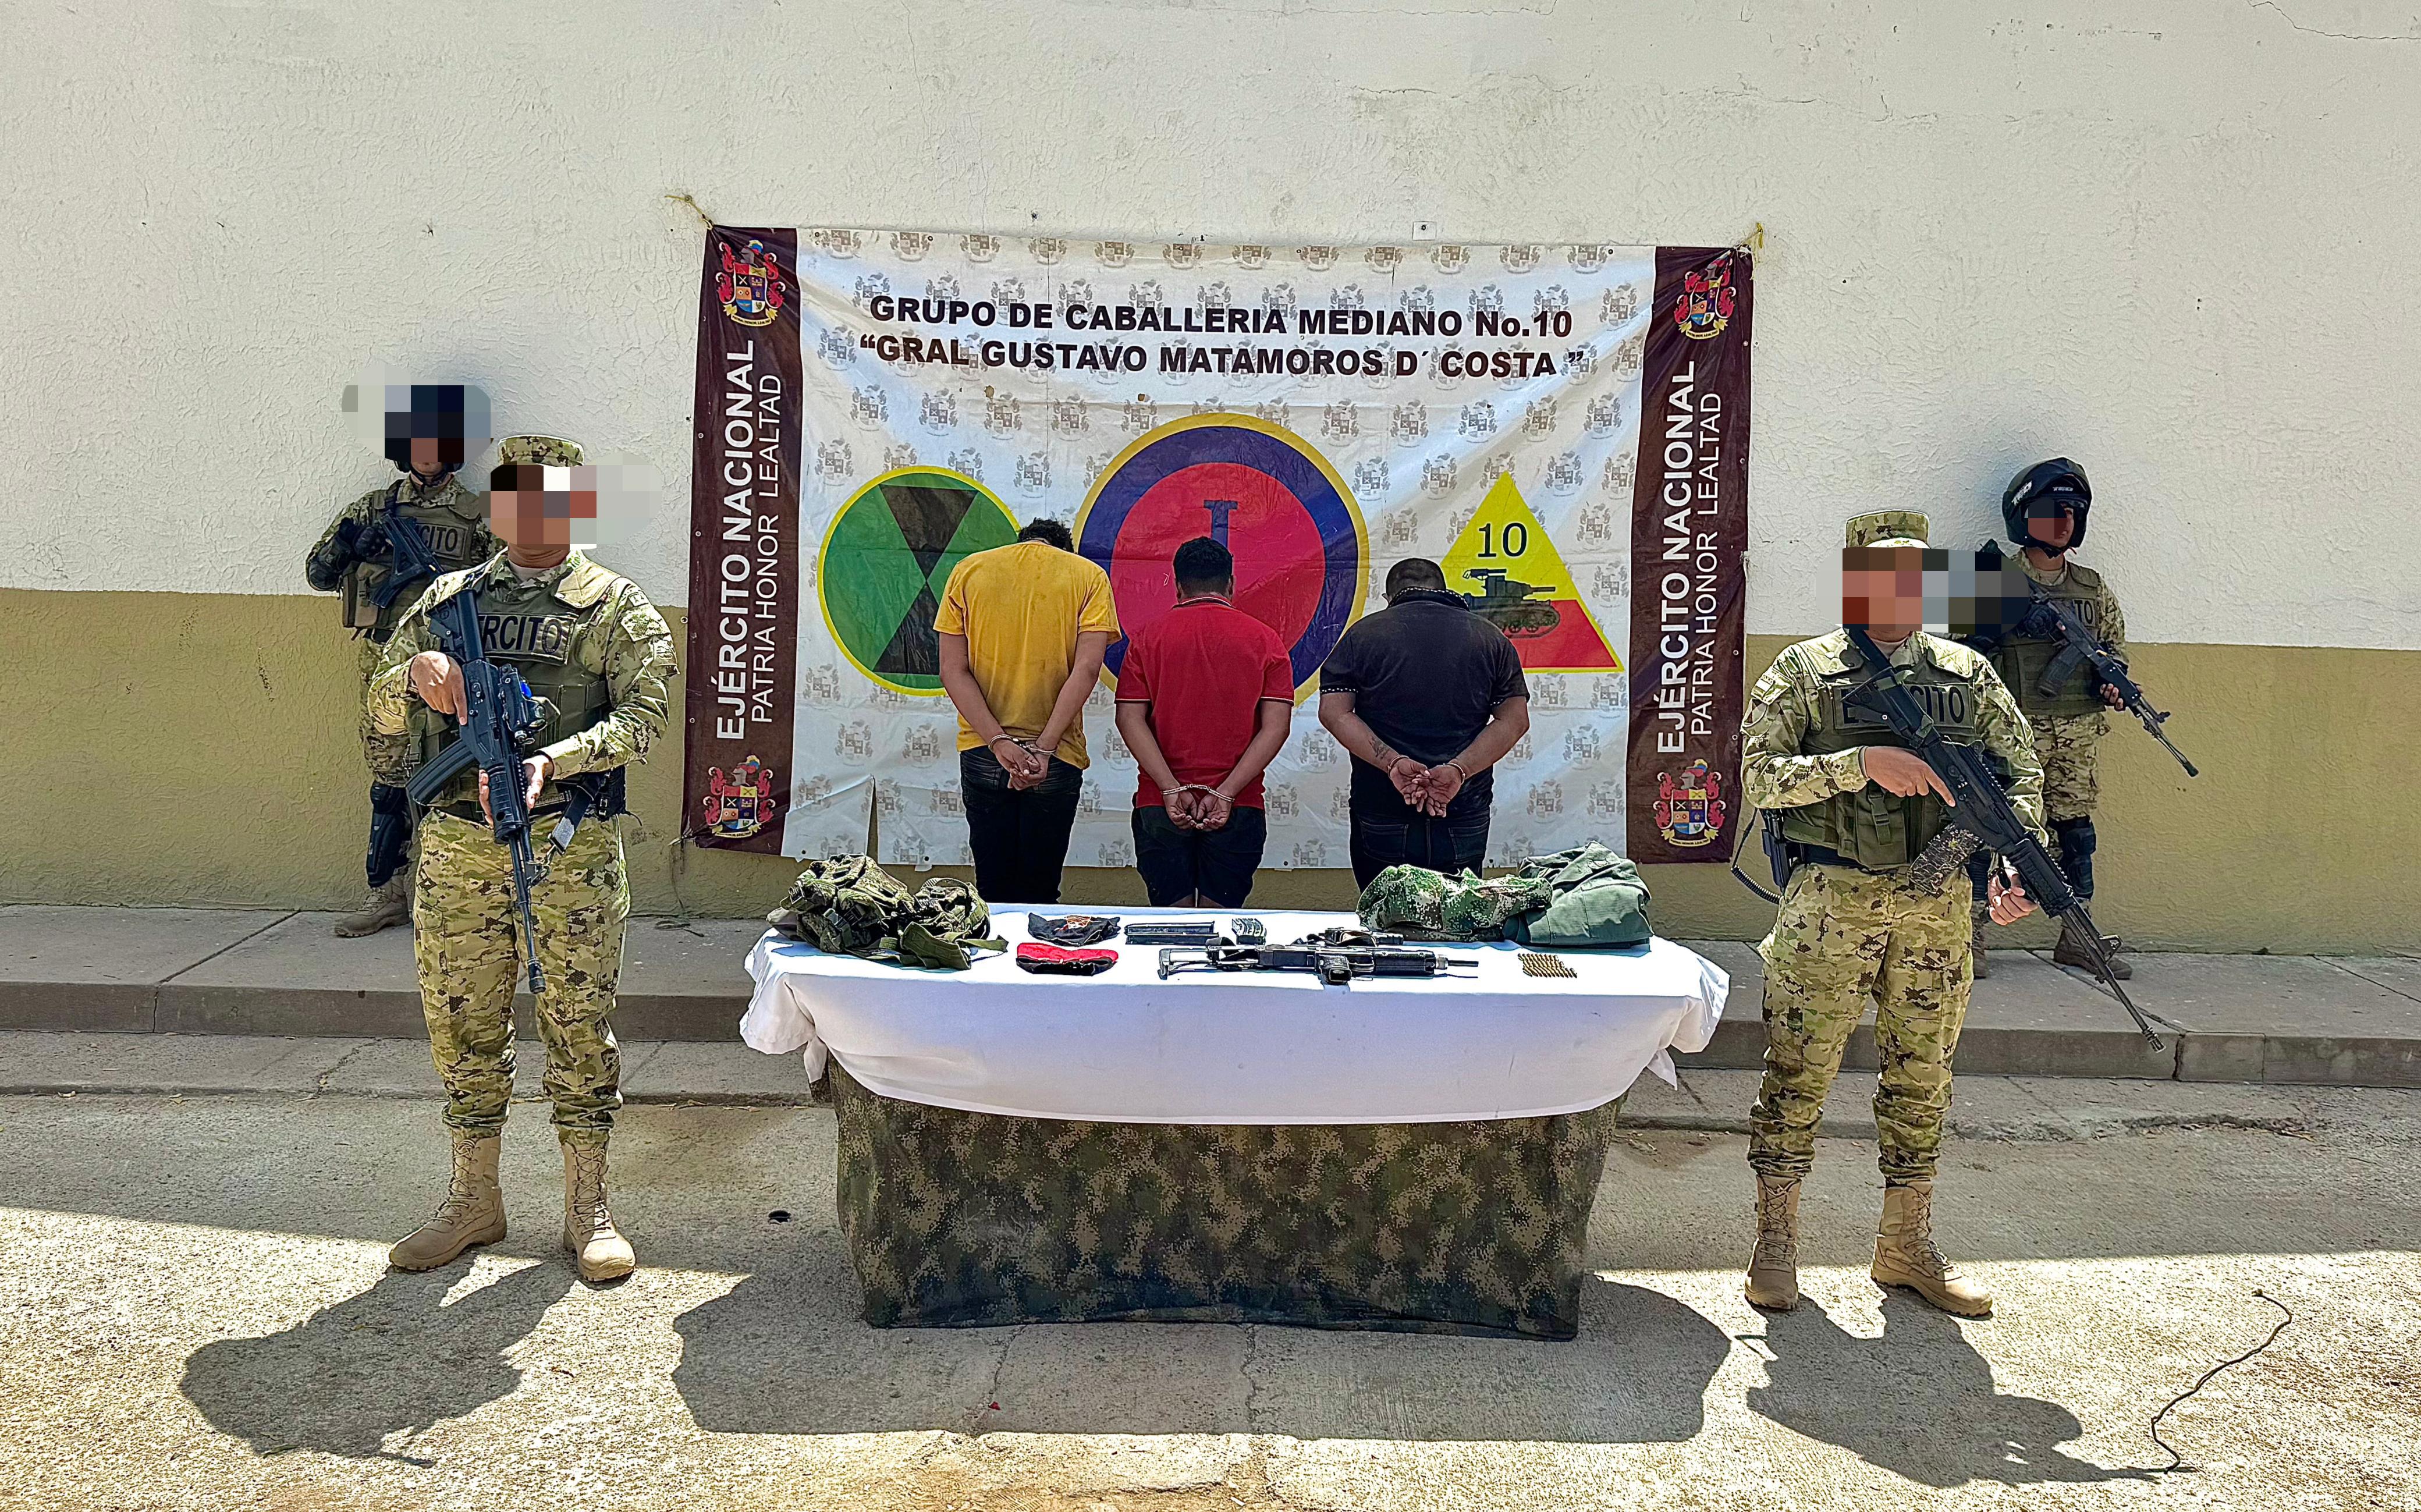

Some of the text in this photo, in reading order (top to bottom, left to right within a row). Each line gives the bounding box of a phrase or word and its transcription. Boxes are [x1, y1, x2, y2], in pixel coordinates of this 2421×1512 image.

[870, 295, 1572, 338] GRUPO DE CABALLERIA MEDIANO No.10
[981, 340, 1147, 371] GUSTAVO
[1160, 347, 1383, 376] MATAMOROS
[1440, 351, 1557, 378] COSTA
[722, 340, 754, 541] NACIONAL
[751, 375, 781, 722] PATRIA HONOR LEALTAD
[1478, 522, 1527, 558] 10
[1654, 361, 1695, 753] EJÉRCITO NACIONAL
[1691, 393, 1721, 734] PATRIA HONOR LEALTAD
[711, 554, 750, 744] EJÉRCITO
